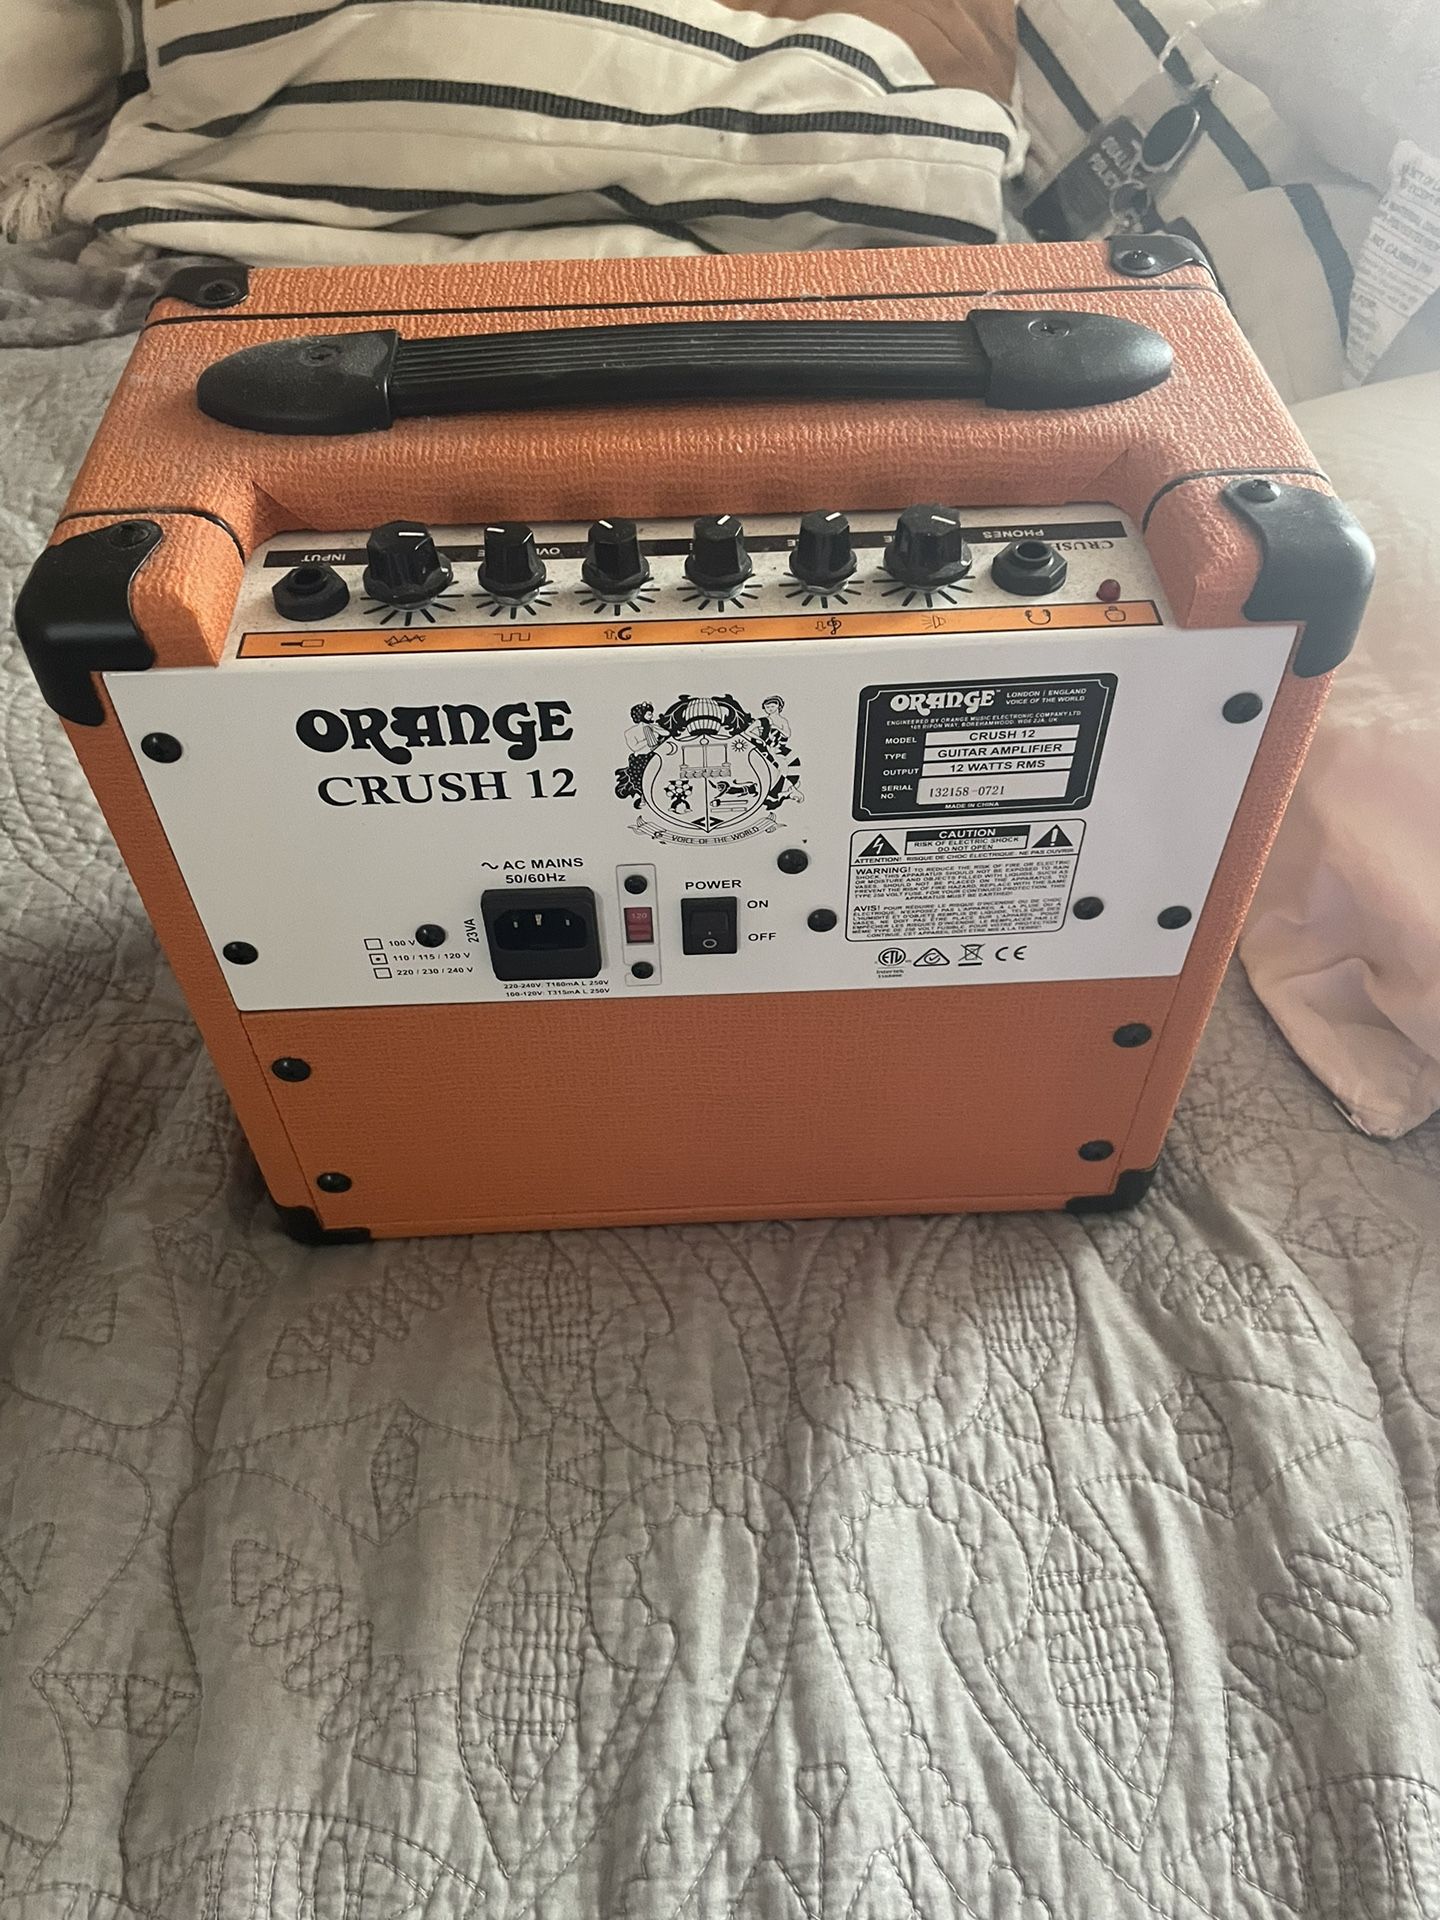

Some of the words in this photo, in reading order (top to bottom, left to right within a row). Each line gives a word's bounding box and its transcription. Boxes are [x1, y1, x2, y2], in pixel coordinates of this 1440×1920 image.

[982, 529, 1044, 538] PHONES
[301, 554, 346, 562] INPUT
[1006, 690, 1042, 698] LONDON
[1048, 688, 1087, 696] ENGLAND
[890, 690, 995, 716] ORANGE
[296, 700, 574, 764] ORANGE
[969, 730, 1016, 741] CRUSH
[1021, 729, 1035, 738] 12
[885, 736, 917, 744] MODEL
[938, 746, 988, 758] GUITAR
[990, 744, 1062, 756] AMPLIFIER
[950, 764, 964, 772] 12
[968, 761, 1012, 772] WATTS
[1016, 759, 1046, 769] RMS
[883, 767, 919, 776] OUTPUT
[318, 770, 512, 806] CRUSH
[526, 768, 577, 799] 12
[882, 784, 912, 792] SERIAL
[672, 834, 693, 844] VOICE
[730, 826, 760, 840] WORLD
[939, 828, 996, 839] CAUTION
[503, 860, 526, 870] AC
[531, 858, 584, 869] MAINS
[856, 866, 911, 876] WARNING!
[506, 873, 566, 884] 50/60Hz
[685, 879, 742, 890] POWER
[747, 900, 769, 909] ON
[464, 918, 479, 943] 23VA
[748, 932, 777, 942] OFF
